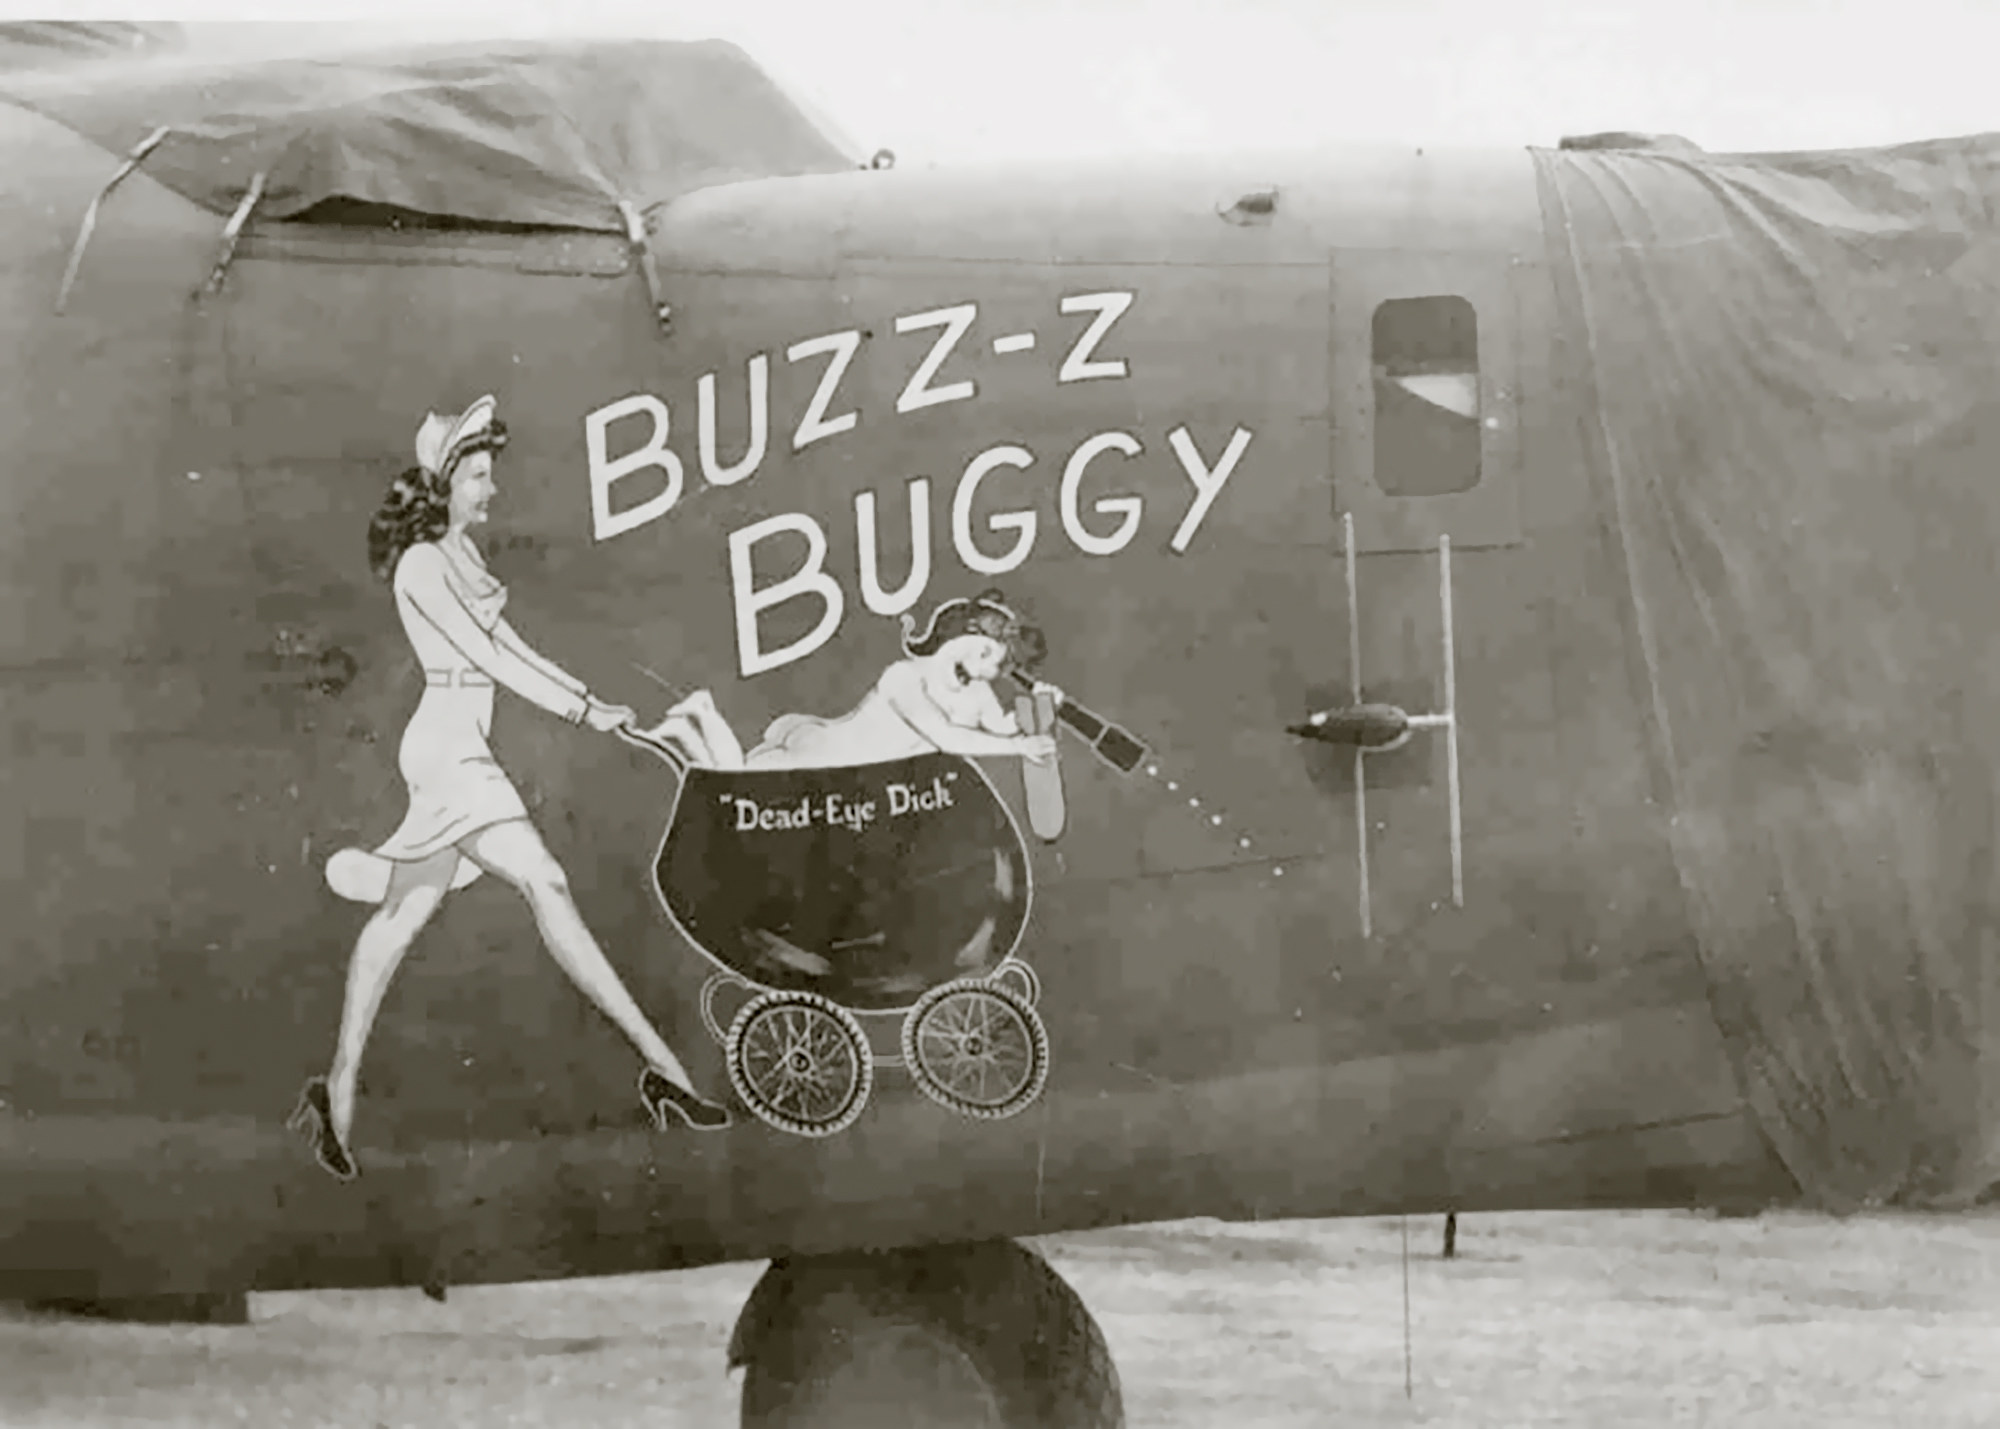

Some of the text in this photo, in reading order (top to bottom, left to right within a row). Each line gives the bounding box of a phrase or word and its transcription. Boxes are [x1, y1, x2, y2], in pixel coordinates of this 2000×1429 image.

[585, 291, 1134, 541] BUZZ-Z
[728, 426, 1253, 677] BUGGY
[719, 772, 958, 832] "Dead-Eye Dick"
